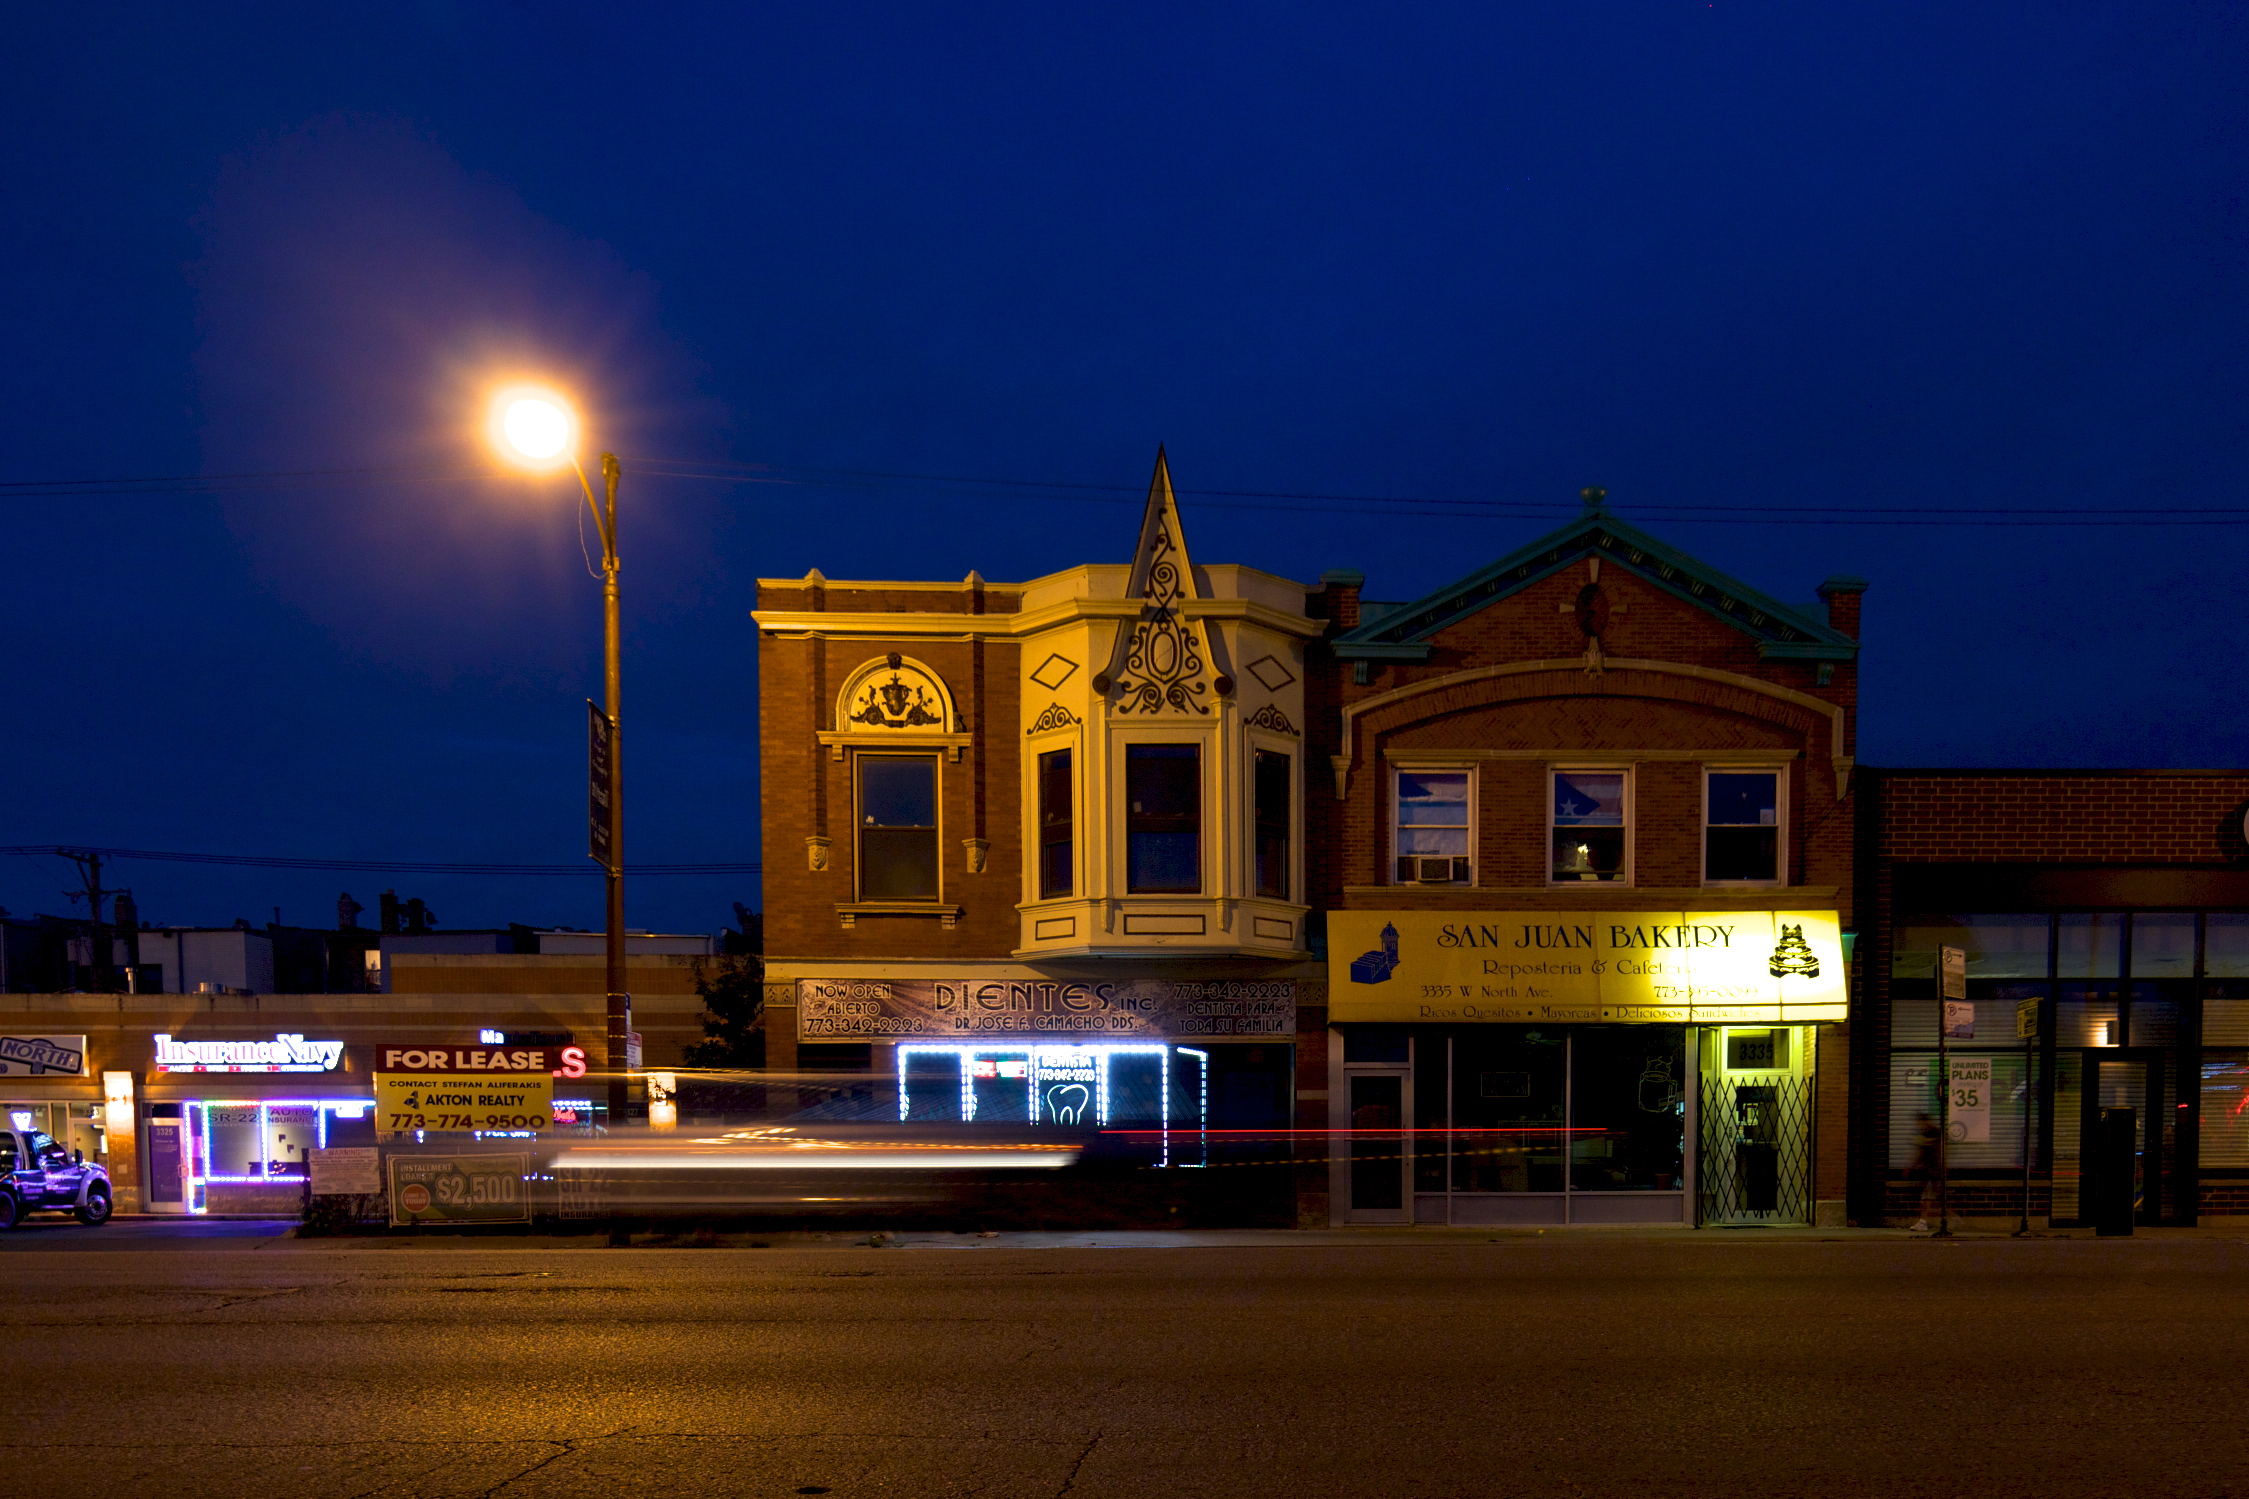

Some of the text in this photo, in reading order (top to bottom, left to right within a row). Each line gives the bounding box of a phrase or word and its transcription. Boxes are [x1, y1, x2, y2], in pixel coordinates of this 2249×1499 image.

[1436, 922, 1737, 949] SAN JUAN BAKERY
[1483, 958, 1582, 980] Reposteria
[1590, 957, 1609, 976] &
[815, 984, 891, 999] NOW OPEN
[933, 982, 1159, 1012] DIENTES INC.
[1174, 982, 1291, 999] 773-342-2223
[1420, 985, 1553, 998] 3335 W North Ave.
[1653, 985, 1759, 999] 773-395-0099
[826, 1001, 881, 1016] ABIERTO
[1186, 1001, 1276, 1016] DENTISTA PARA
[1420, 1005, 1457, 1018] Ricos
[1541, 1005, 1597, 1021] Mayorcas
[1616, 1006, 1683, 1020] Deliciosos
[805, 1017, 924, 1034] 773-342-2223
[954, 1016, 1139, 1031] DR JOSE F. CAMACHO DDS.
[1180, 1018, 1284, 1033] TODA SU FAMILIA
[2, 1041, 72, 1066] NORTH
[1739, 1043, 1774, 1061] 3335
[385, 1049, 545, 1071] FOR LEASE
[1951, 1061, 1989, 1069] UNLIMITED
[1951, 1070, 1989, 1080] PLANS
[389, 1080, 438, 1088] CONTACT
[442, 1081, 483, 1089] STEFFAN
[425, 1094, 525, 1107] AKTON REALTY
[209, 1113, 258, 1123] SR-22
[270, 1107, 313, 1116] AUTO
[267, 1116, 314, 1124] NSURANC
[390, 1113, 546, 1130] 773-774-9500
[156, 1128, 174, 1137] 3325
[400, 1163, 453, 1173] INSTALLMENT
[400, 1172, 427, 1181] LOANS
[437, 1175, 515, 1210] $2,500
[560, 1210, 610, 1220] INSURANCE
